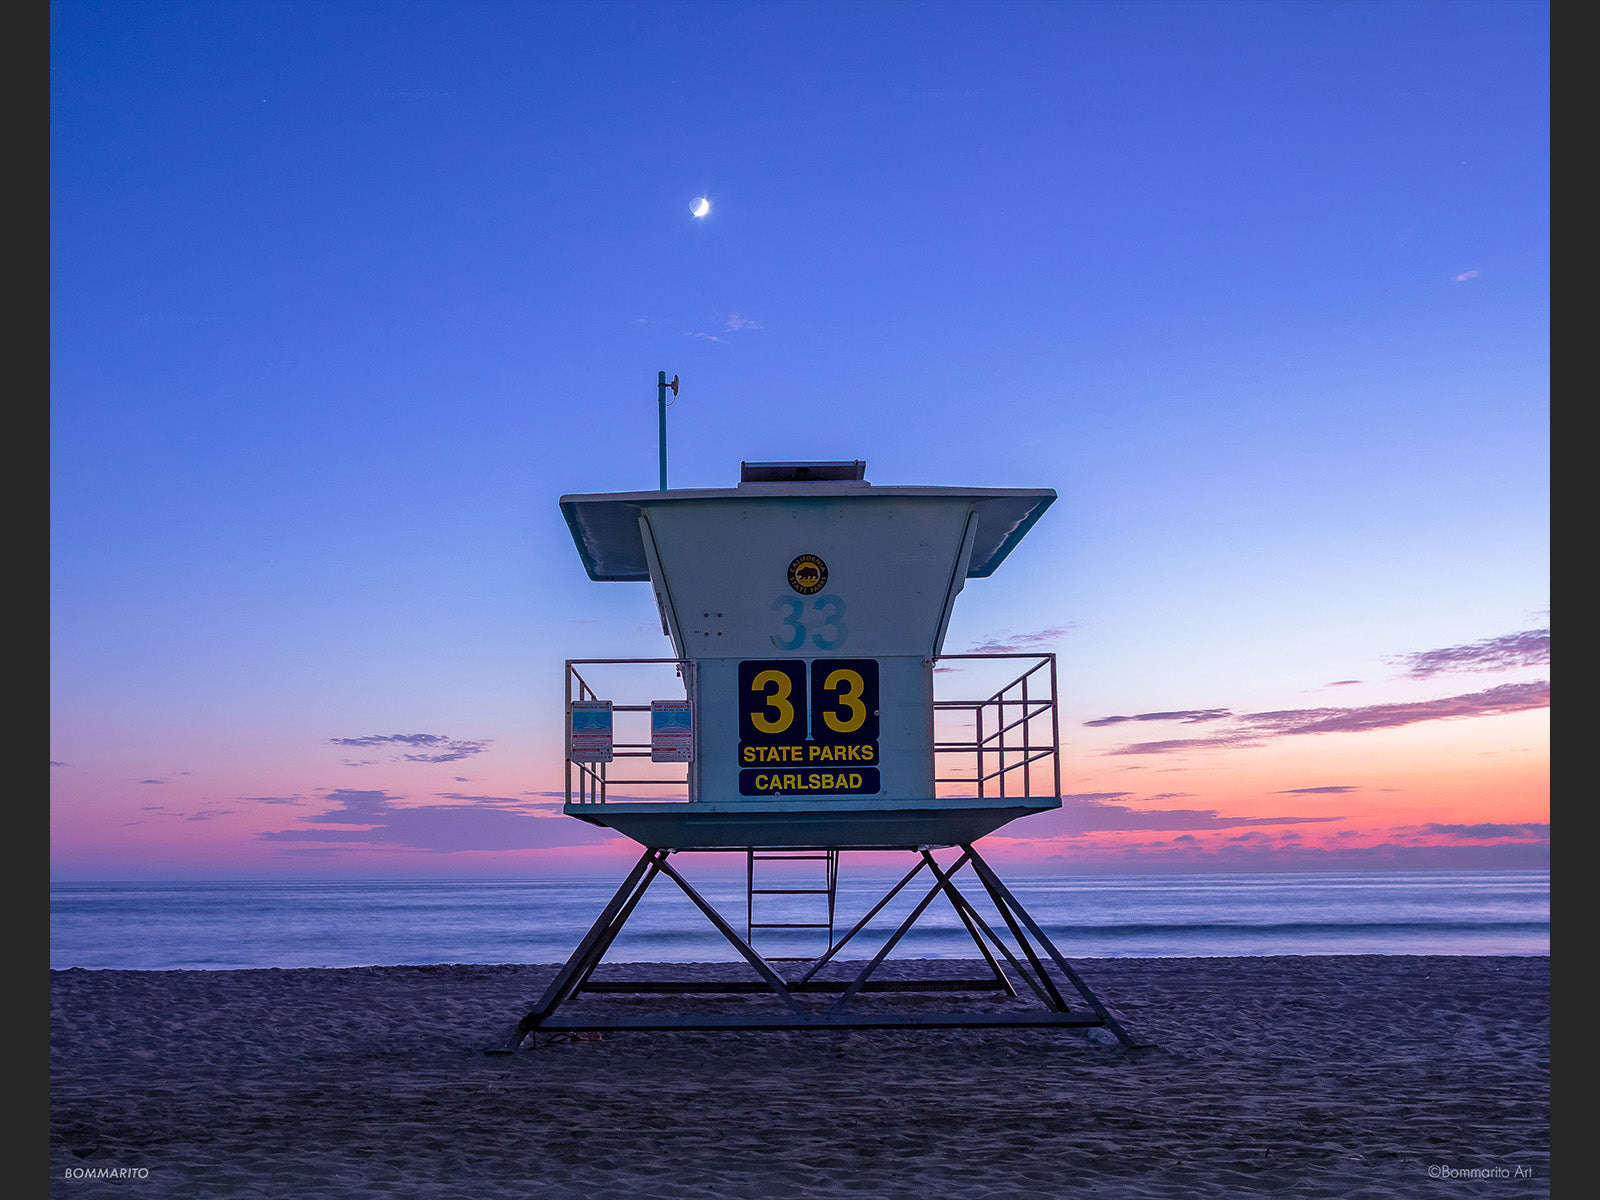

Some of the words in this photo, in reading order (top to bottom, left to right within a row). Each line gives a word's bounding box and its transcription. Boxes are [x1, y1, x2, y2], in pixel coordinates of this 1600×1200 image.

[790, 555, 826, 573] CALIFORNIA
[770, 594, 849, 651] 33
[743, 746, 804, 762] STATE
[808, 745, 875, 761] PARKS
[755, 773, 863, 790] CARLSBAD
